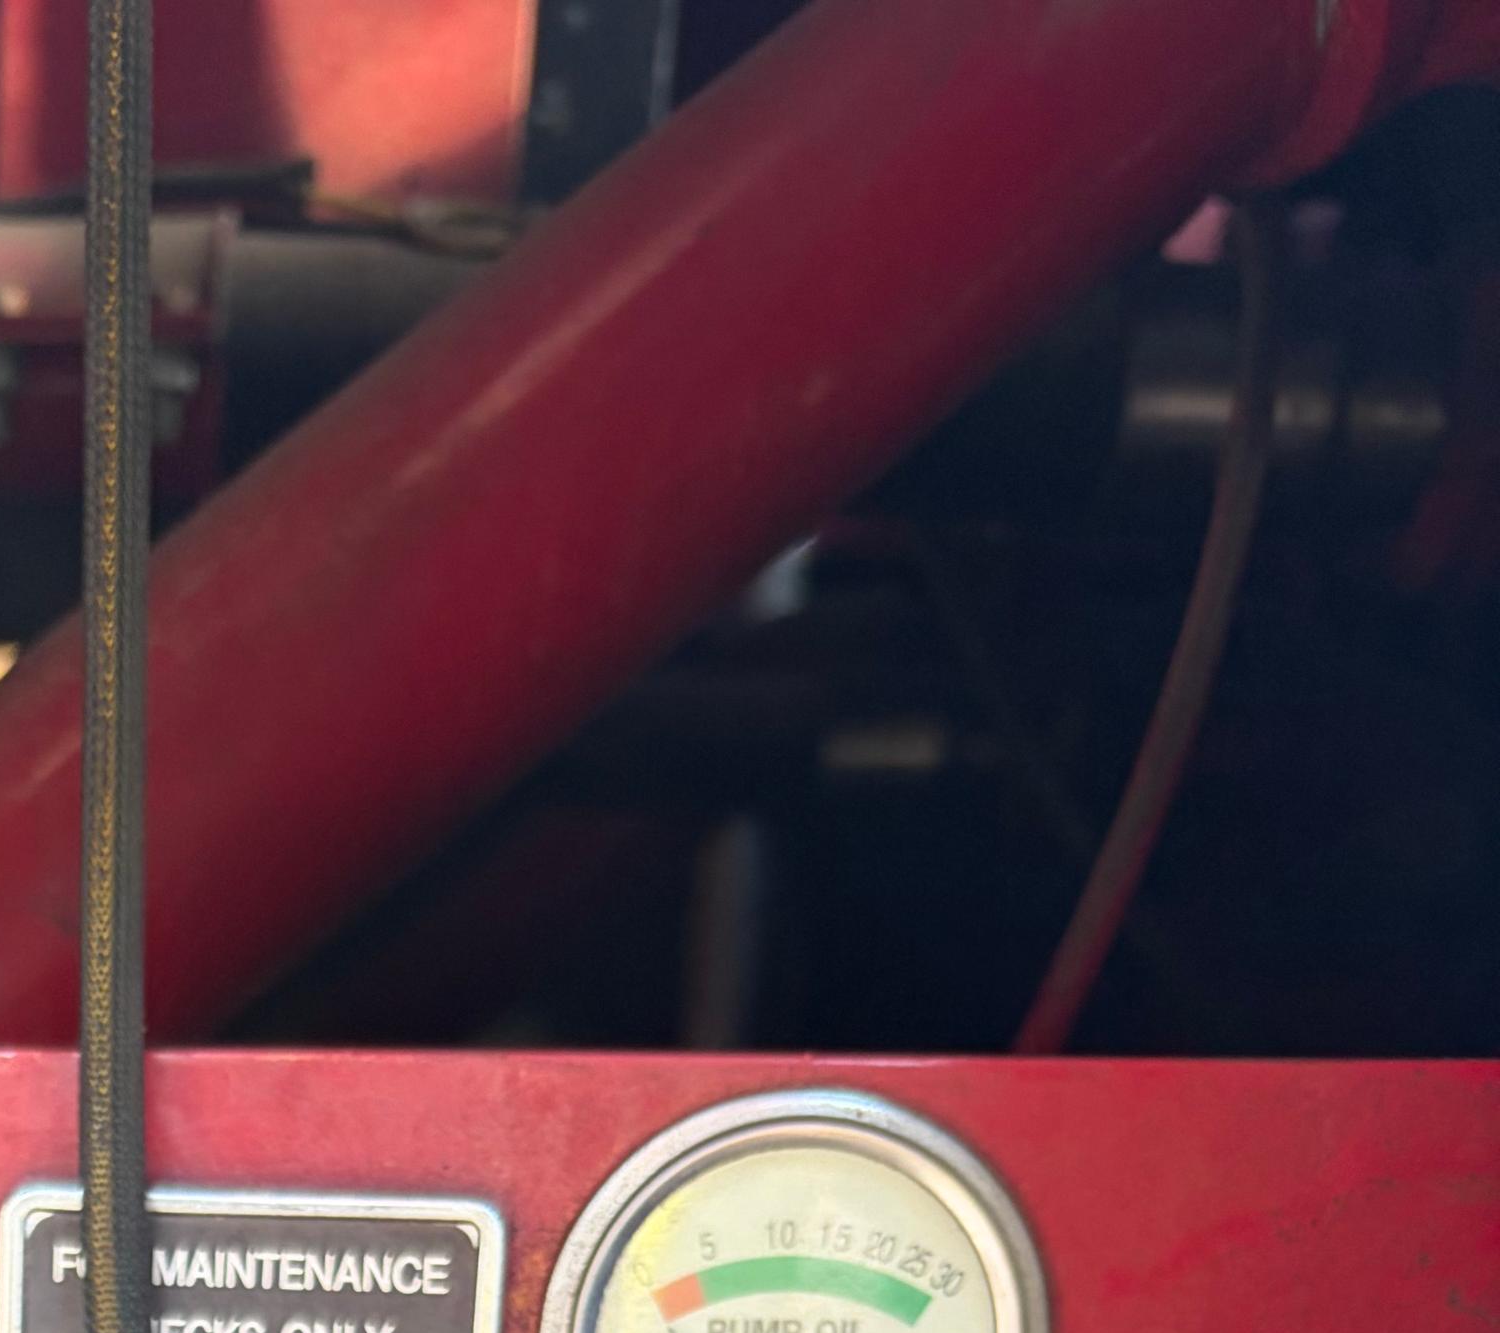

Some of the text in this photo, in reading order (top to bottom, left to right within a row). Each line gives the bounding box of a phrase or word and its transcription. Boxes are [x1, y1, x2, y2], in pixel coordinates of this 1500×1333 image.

[152, 1245, 452, 1296] MAINTENANCE
[699, 1232, 716, 1261] 5
[765, 1220, 797, 1249] 10
[820, 1221, 852, 1252] 15
[863, 1231, 897, 1264] 20
[898, 1244, 933, 1278] 25
[930, 1262, 964, 1298] 30
